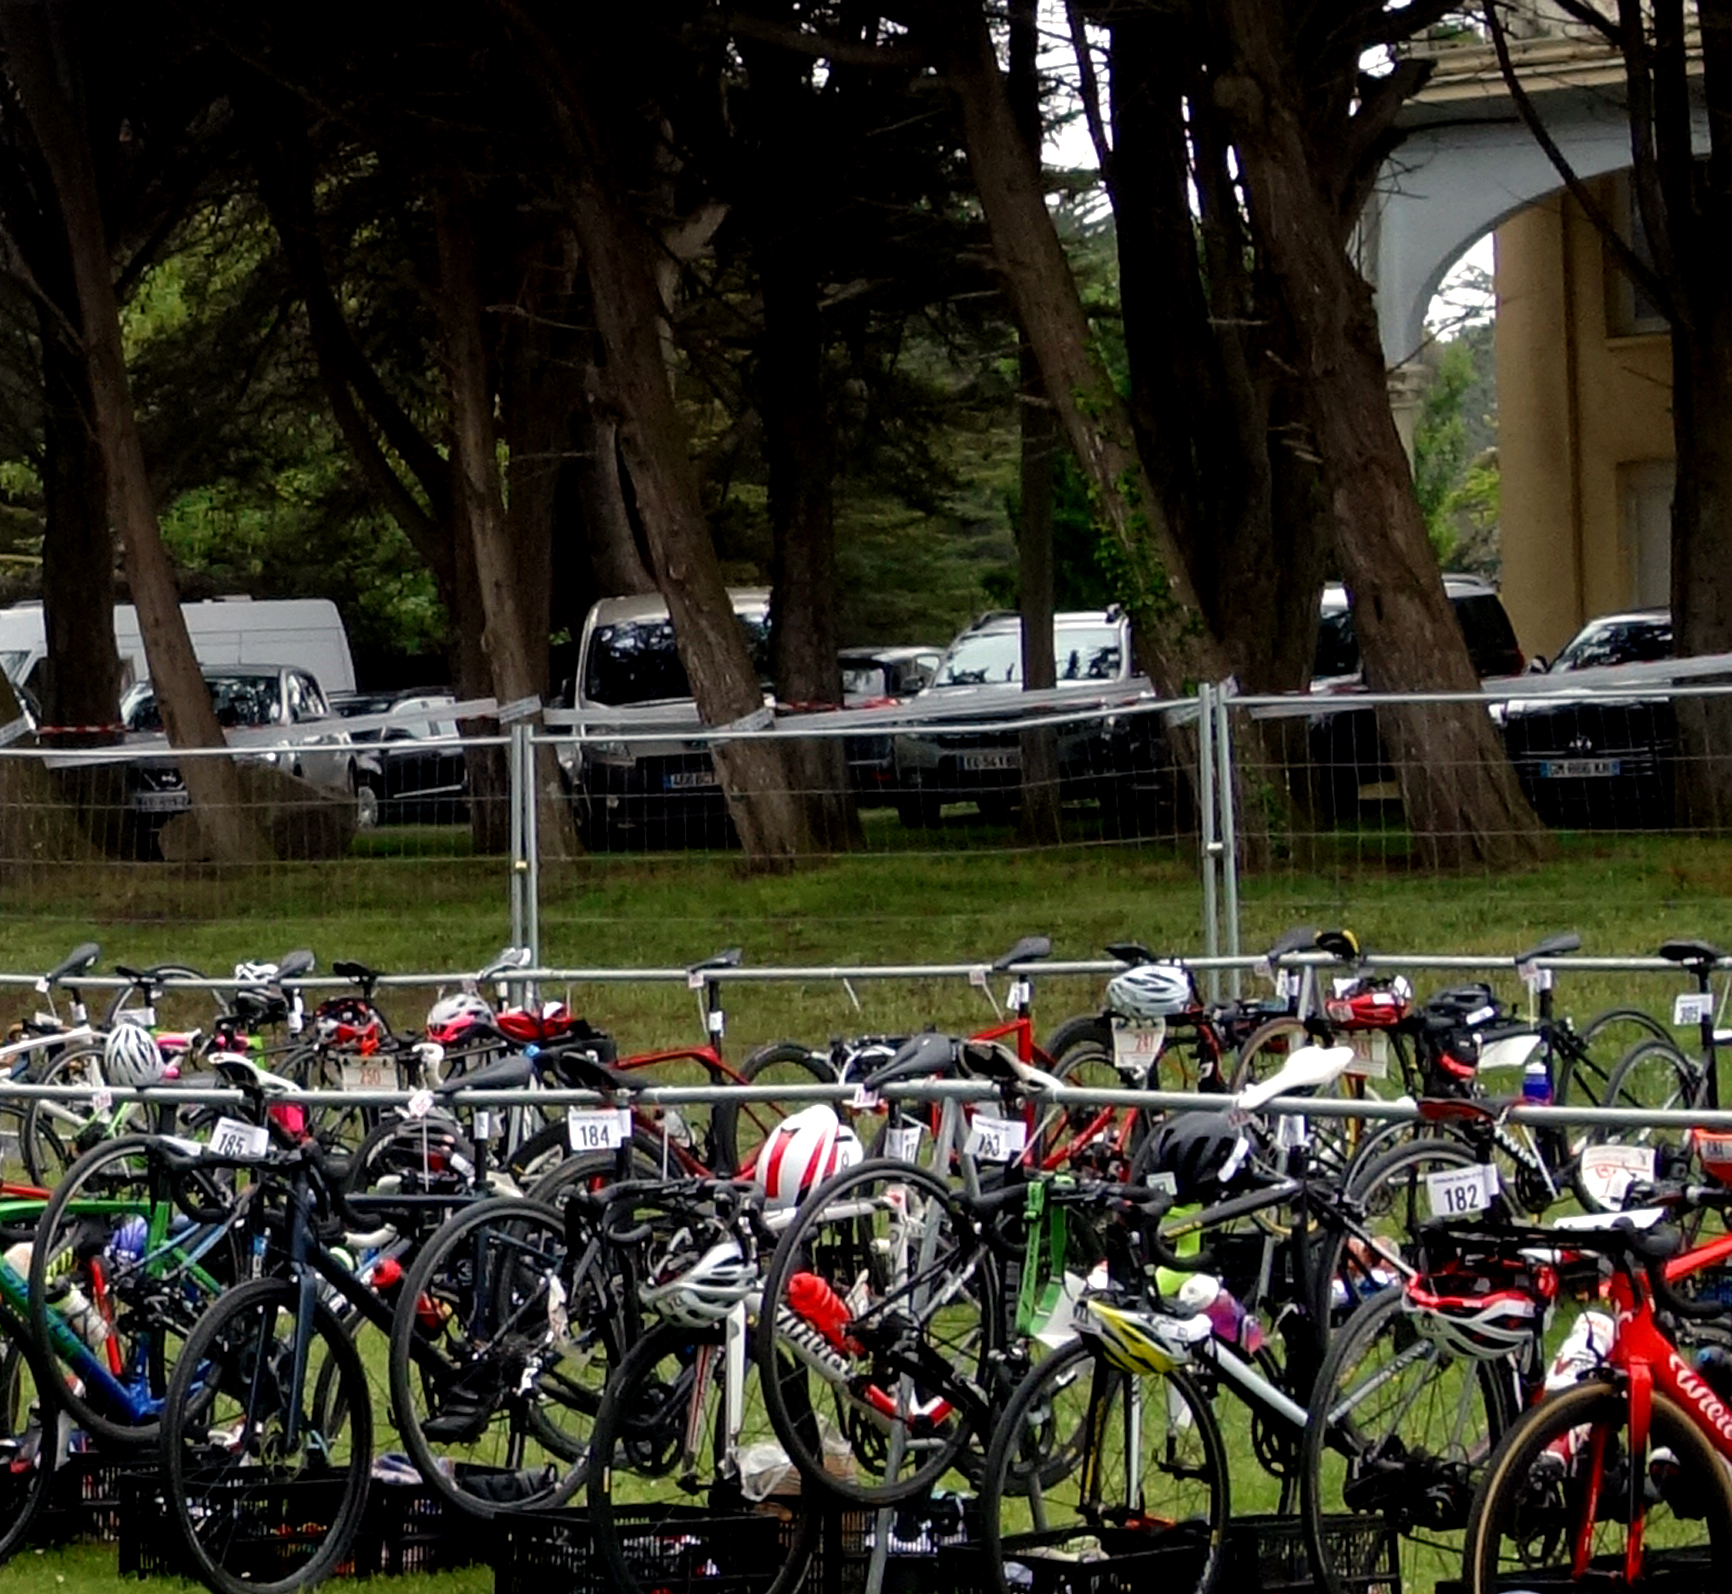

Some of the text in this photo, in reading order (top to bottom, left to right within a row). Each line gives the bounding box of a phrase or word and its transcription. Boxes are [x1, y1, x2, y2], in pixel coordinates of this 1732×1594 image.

[217, 1132, 246, 1156] 185
[580, 1124, 610, 1148] 184
[1444, 1184, 1479, 1213] 182
